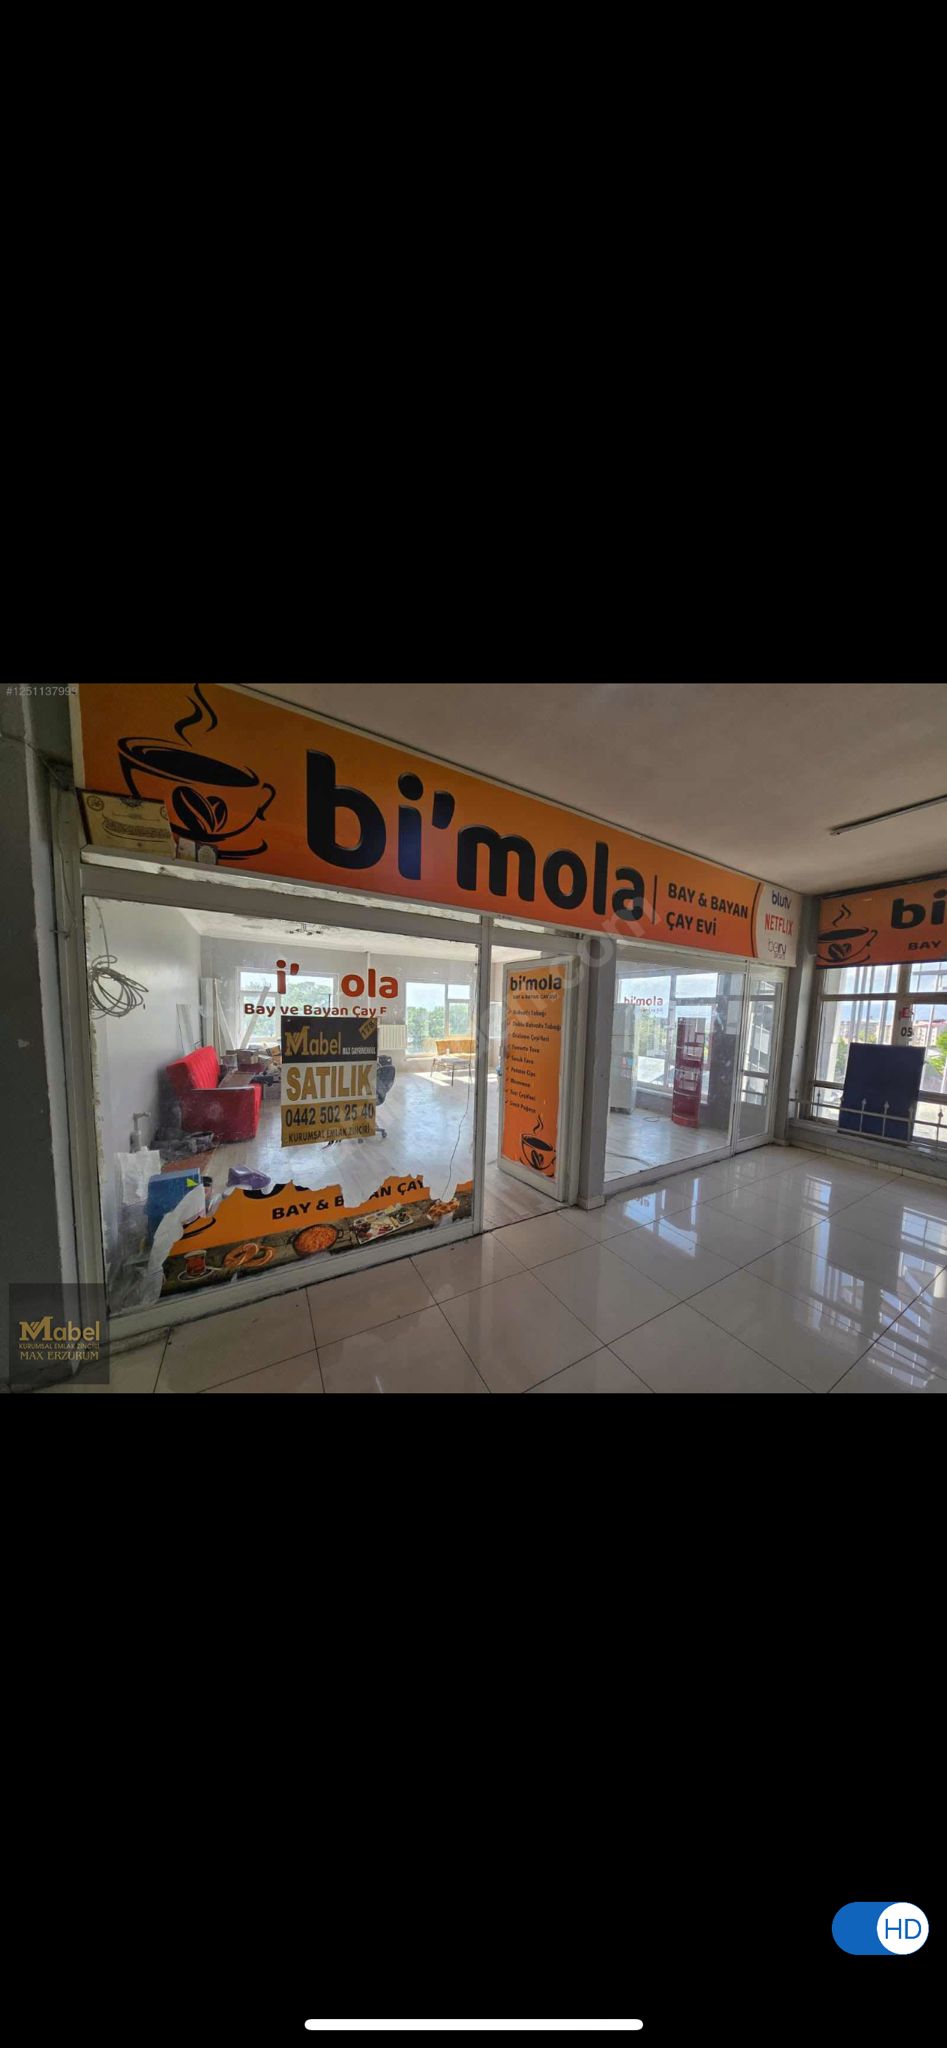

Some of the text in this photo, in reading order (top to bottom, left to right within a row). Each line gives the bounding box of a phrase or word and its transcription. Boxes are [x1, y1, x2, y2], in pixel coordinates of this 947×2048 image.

[668, 883, 749, 919] BAY & BAYAN
[666, 911, 717, 936] ÇAY EVİ
[764, 913, 794, 936] NETFLIX
[908, 940, 942, 951] BAY
[510, 974, 562, 991] bi'mola
[244, 1003, 276, 1017] Bay
[281, 1006, 299, 1015] ve
[303, 1004, 348, 1018] Bayan
[352, 1006, 377, 1019] Çay
[284, 1025, 342, 1056] Mabel
[286, 1065, 373, 1102] SATILIK
[285, 1102, 374, 1127] 0442 502 25 40
[272, 1203, 310, 1220] BAY
[316, 1200, 329, 1211] &
